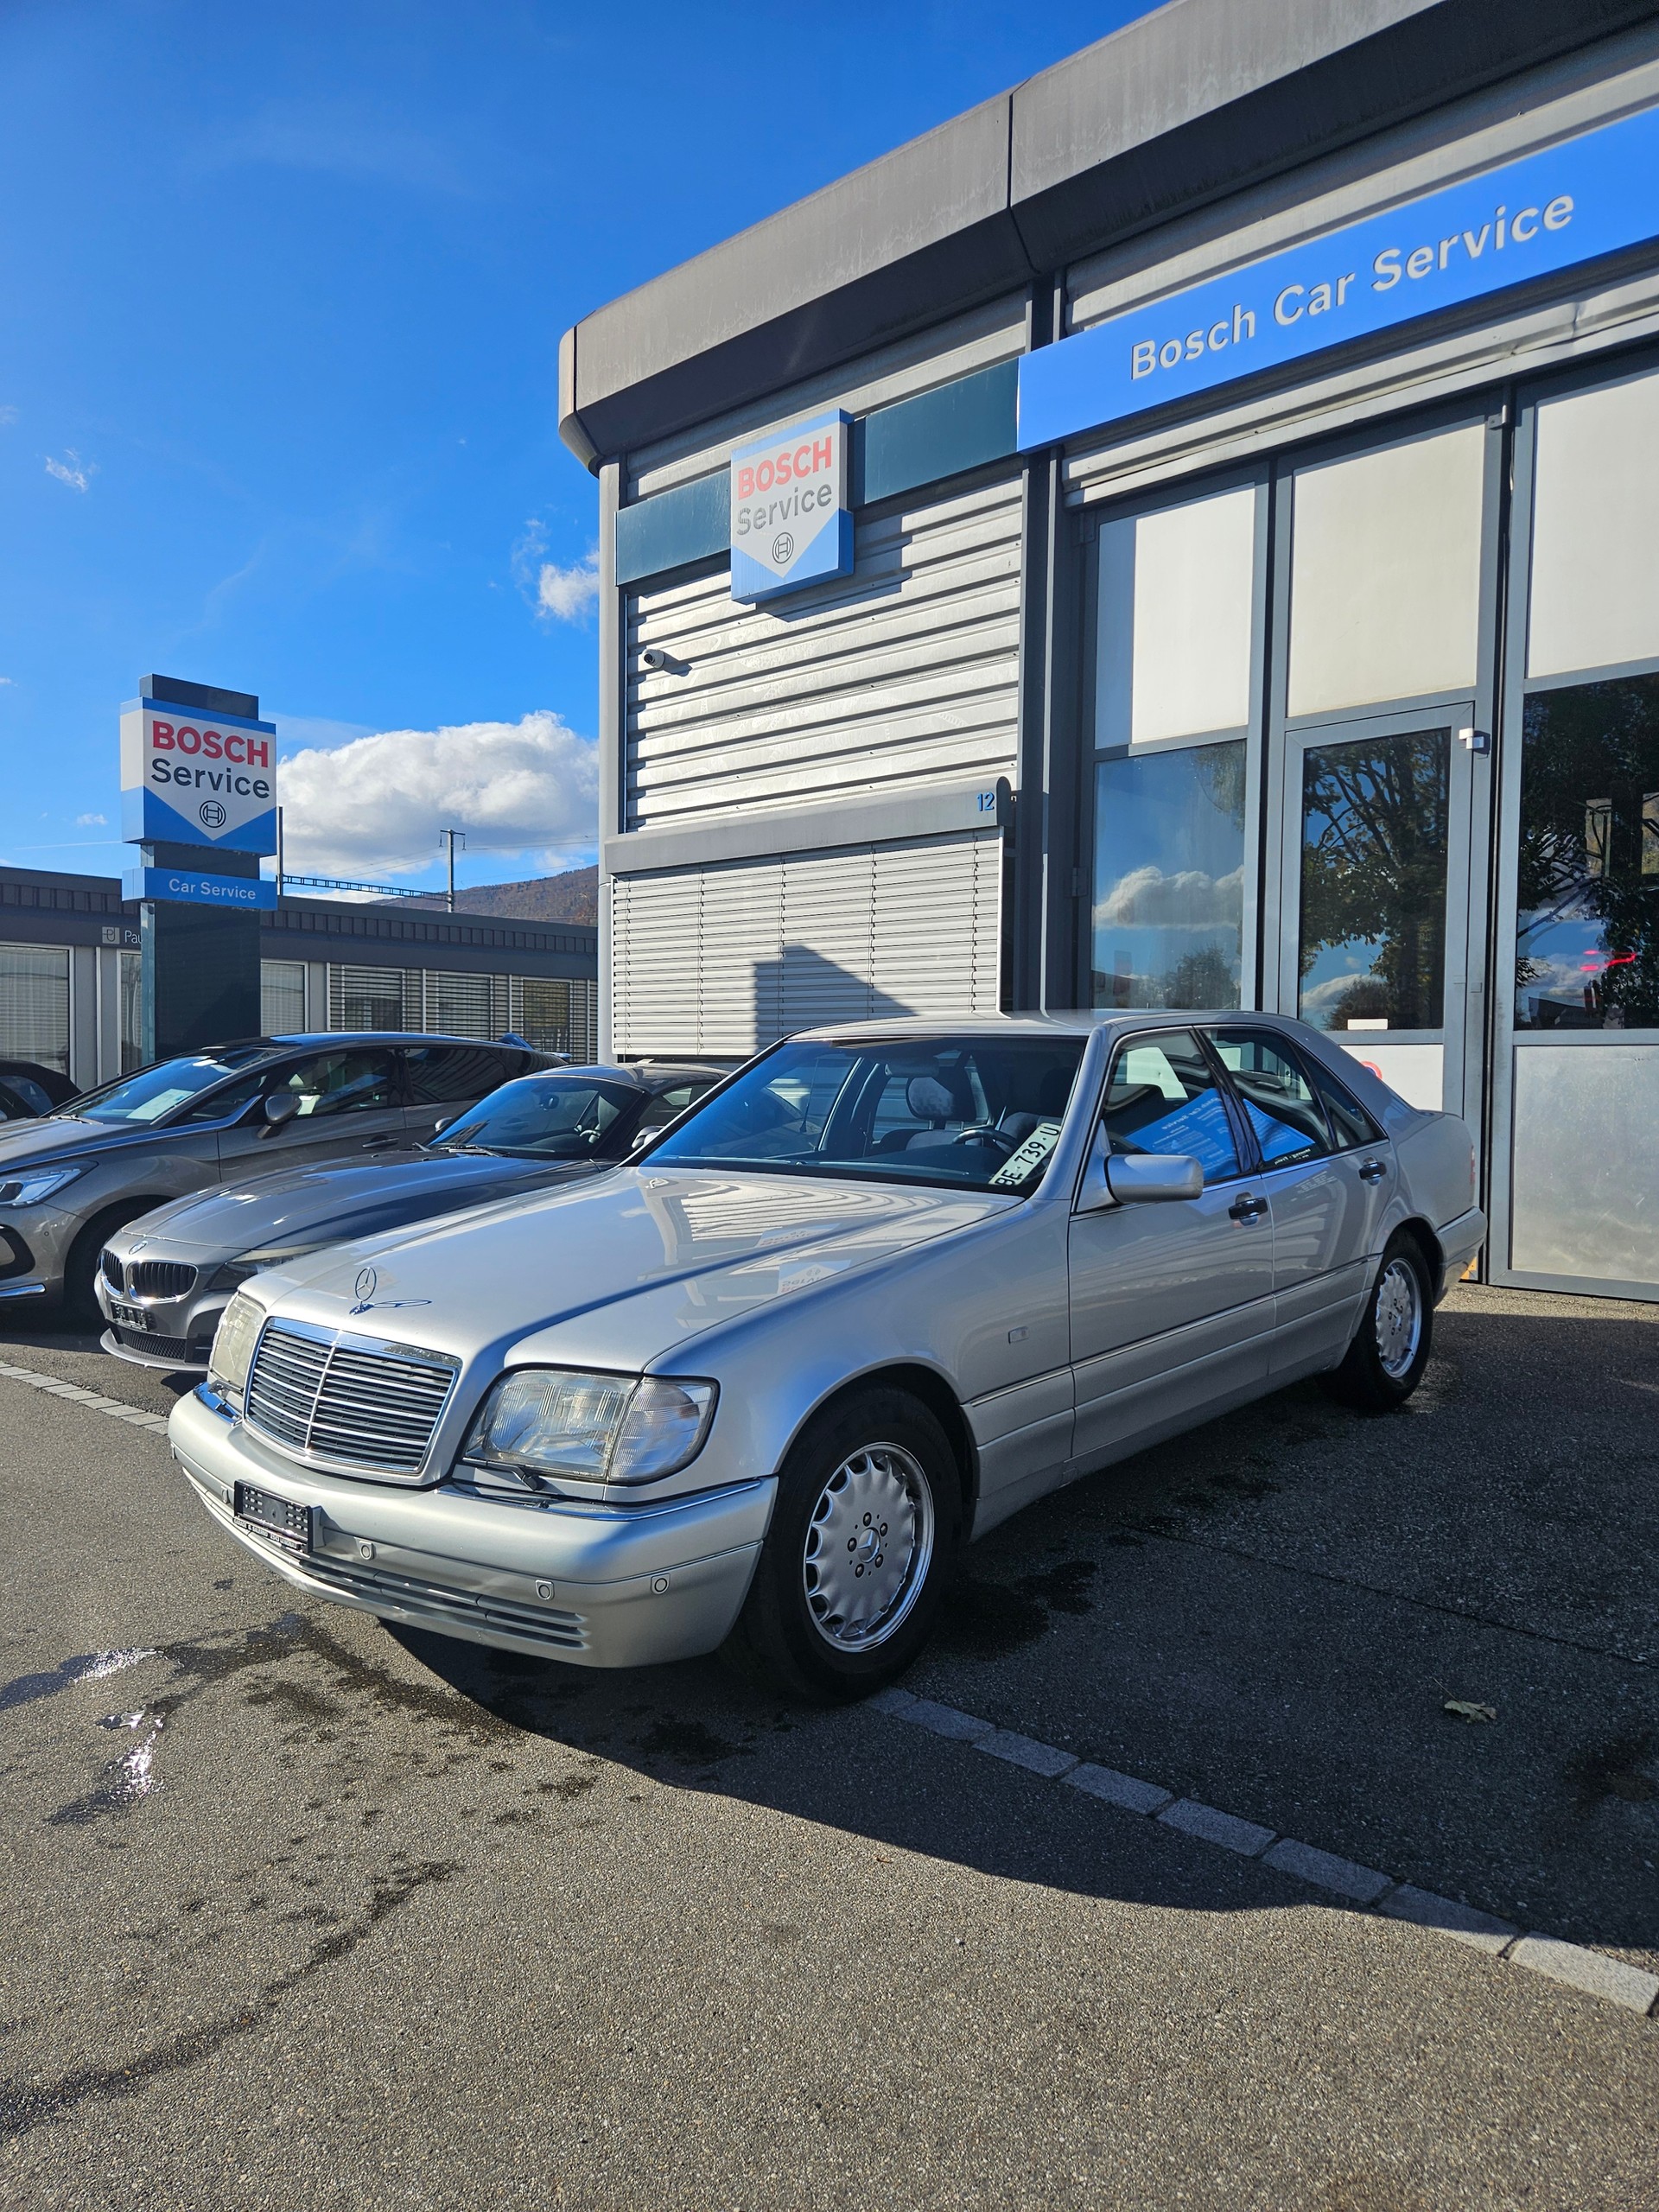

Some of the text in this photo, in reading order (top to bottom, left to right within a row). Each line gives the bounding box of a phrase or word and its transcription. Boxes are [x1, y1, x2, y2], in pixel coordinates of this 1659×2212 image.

[1131, 194, 1574, 381] Bosch Car Service
[738, 435, 832, 500] BOSCH
[737, 484, 832, 536] Service
[153, 720, 269, 768] BOSCH
[151, 758, 270, 799] Service
[976, 791, 995, 812] 12
[168, 878, 257, 900] Car Service
